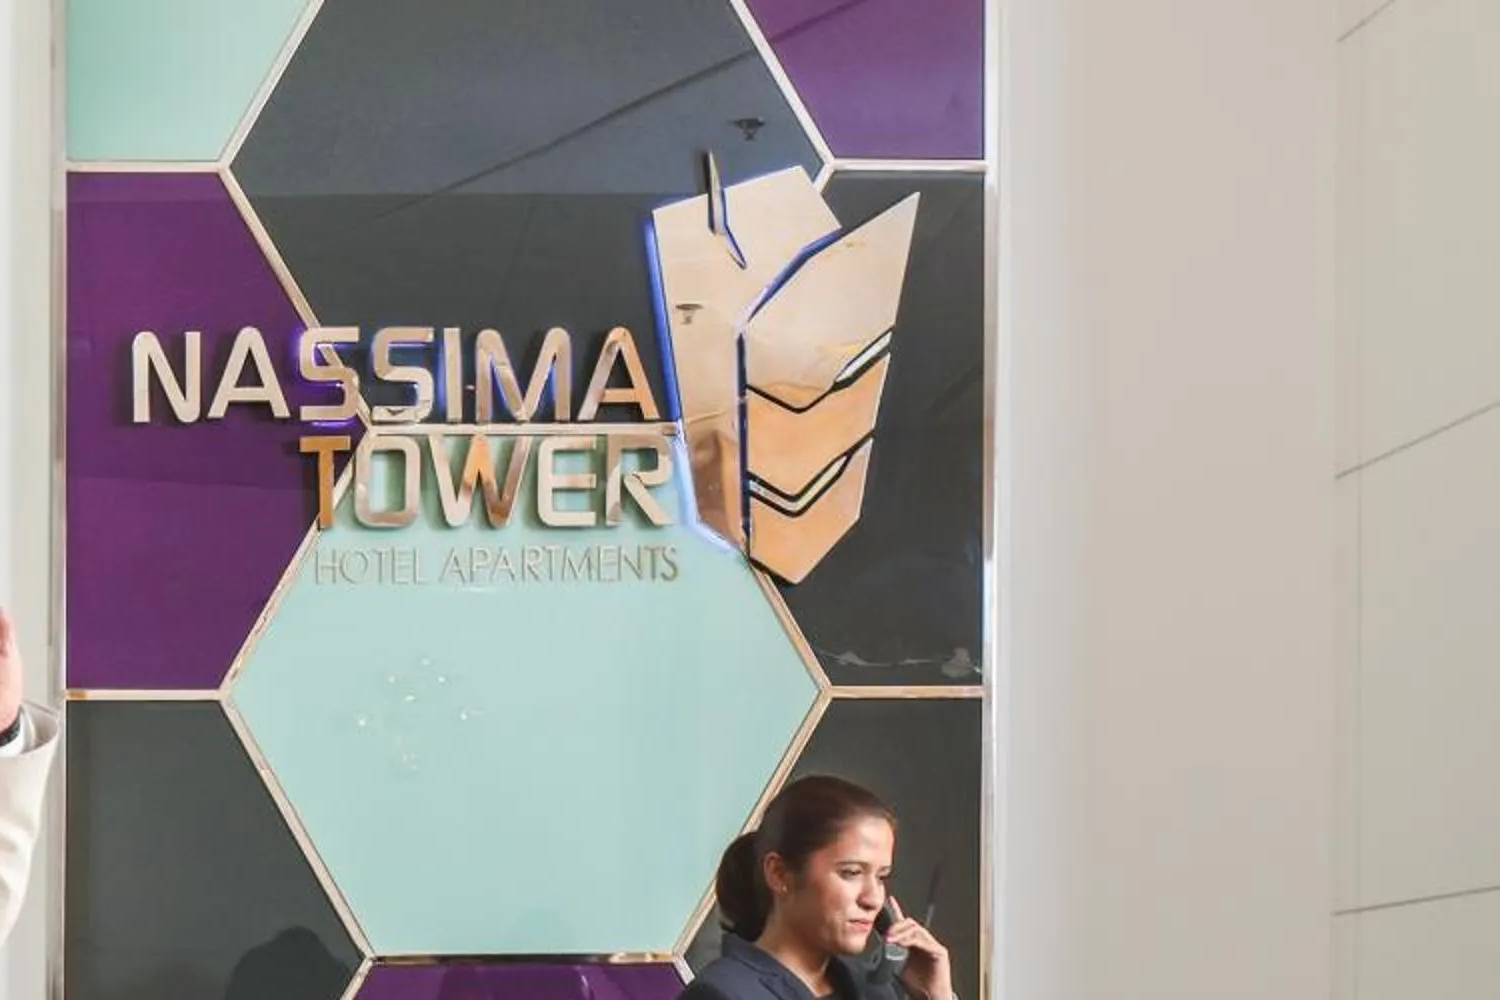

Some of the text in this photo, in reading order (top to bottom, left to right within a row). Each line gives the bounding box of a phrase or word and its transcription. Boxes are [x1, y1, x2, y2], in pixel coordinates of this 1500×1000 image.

[132, 326, 659, 424] NASSIMA
[300, 433, 674, 529] TOWER
[314, 544, 679, 584] HOTEL APARTMENTS
